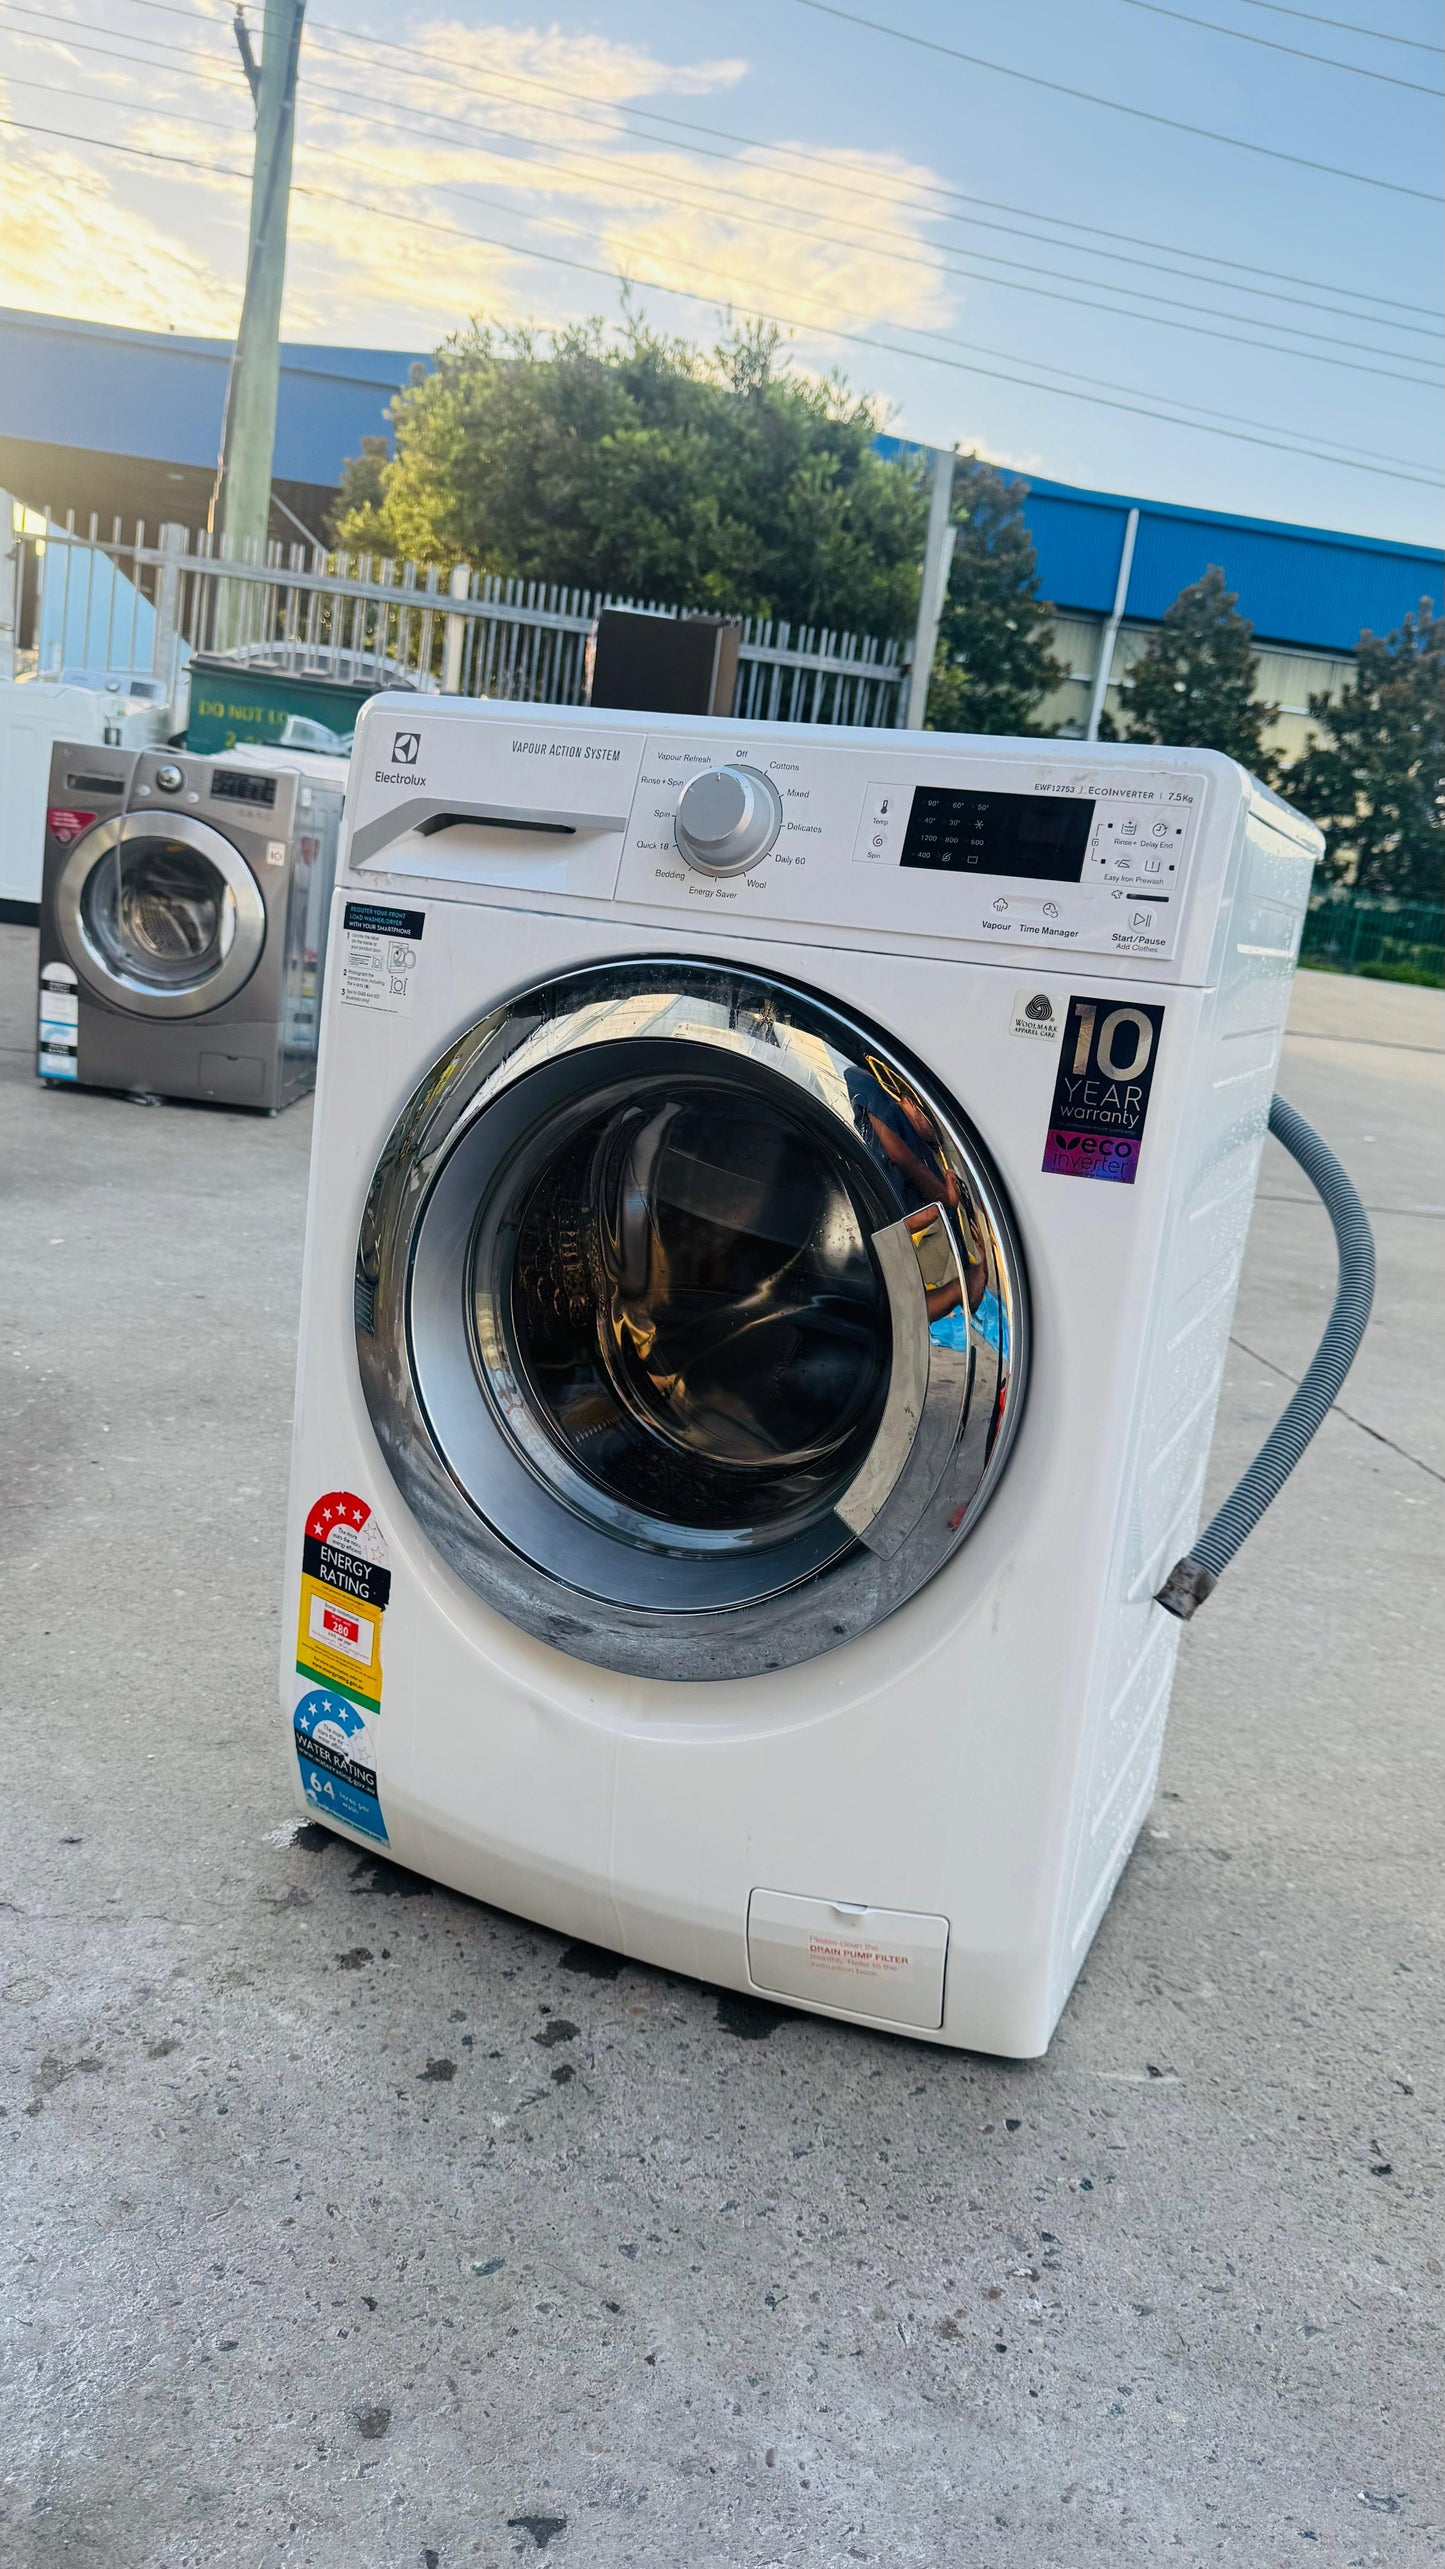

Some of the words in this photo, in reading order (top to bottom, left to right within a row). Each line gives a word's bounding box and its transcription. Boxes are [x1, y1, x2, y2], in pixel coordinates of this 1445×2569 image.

[199, 701, 225, 718] DO
[228, 704, 262, 723] NOT
[512, 740, 546, 755] VAPOUR
[549, 743, 582, 758] ACTION
[584, 746, 621, 762] SYSTEM
[736, 750, 748, 758] Off
[657, 752, 682, 762] Vapour
[683, 754, 712, 764] Refresh
[769, 761, 800, 772] Cottons
[375, 770, 427, 786] Electrolux
[640, 776, 661, 785] Rinse
[668, 778, 684, 788] Spin
[786, 788, 810, 798] Mixed
[1034, 783, 1076, 794] EWF12753
[1168, 792, 1194, 804] 7.5Kg
[654, 809, 671, 819] Spin
[873, 817, 888, 826] Temp
[786, 822, 822, 834] Delicates
[636, 840, 657, 850] Quick
[659, 842, 669, 850] 18
[1140, 840, 1158, 850] Delay
[1160, 842, 1174, 850] End
[774, 854, 794, 866] Daily
[794, 857, 806, 866] 60
[866, 851, 881, 860] Spin
[655, 870, 686, 881] Bedding
[1104, 874, 1120, 883] Easy
[1120, 875, 1134, 884] Iron
[1136, 876, 1164, 886] Prewash
[747, 879, 767, 890] Wool
[688, 886, 714, 898] Energy
[715, 889, 738, 900] Saver
[350, 906, 374, 914] REGISTER
[388, 910, 406, 918] FRONT
[377, 925, 412, 936] SMARTPHONE
[982, 920, 1012, 932] Vapour
[1019, 924, 1040, 934] Time
[1041, 927, 1079, 938] Manager
[1112, 933, 1166, 946] Start/Pause
[1132, 944, 1158, 954] Clothes
[1015, 1019, 1058, 1033] WOOLMARK
[1014, 1027, 1038, 1036] APPAREL
[1040, 1031, 1056, 1039] CARE
[1072, 1003, 1154, 1082] 10
[1064, 1077, 1143, 1112] YEAR
[1060, 1105, 1140, 1129] warranty
[1080, 1137, 1132, 1158] eco
[1052, 1152, 1129, 1174] inverter
[320, 1546, 372, 1580] ENERGY
[320, 1564, 370, 1599] RATING
[332, 1620, 349, 1637] 280
[296, 1732, 332, 1762] WATER
[334, 1755, 374, 1786] RATING
[310, 1771, 336, 1800] 64
[810, 1944, 840, 1956] DRAIN
[843, 1950, 872, 1960] PUMP
[875, 1954, 909, 1964] FILTER
